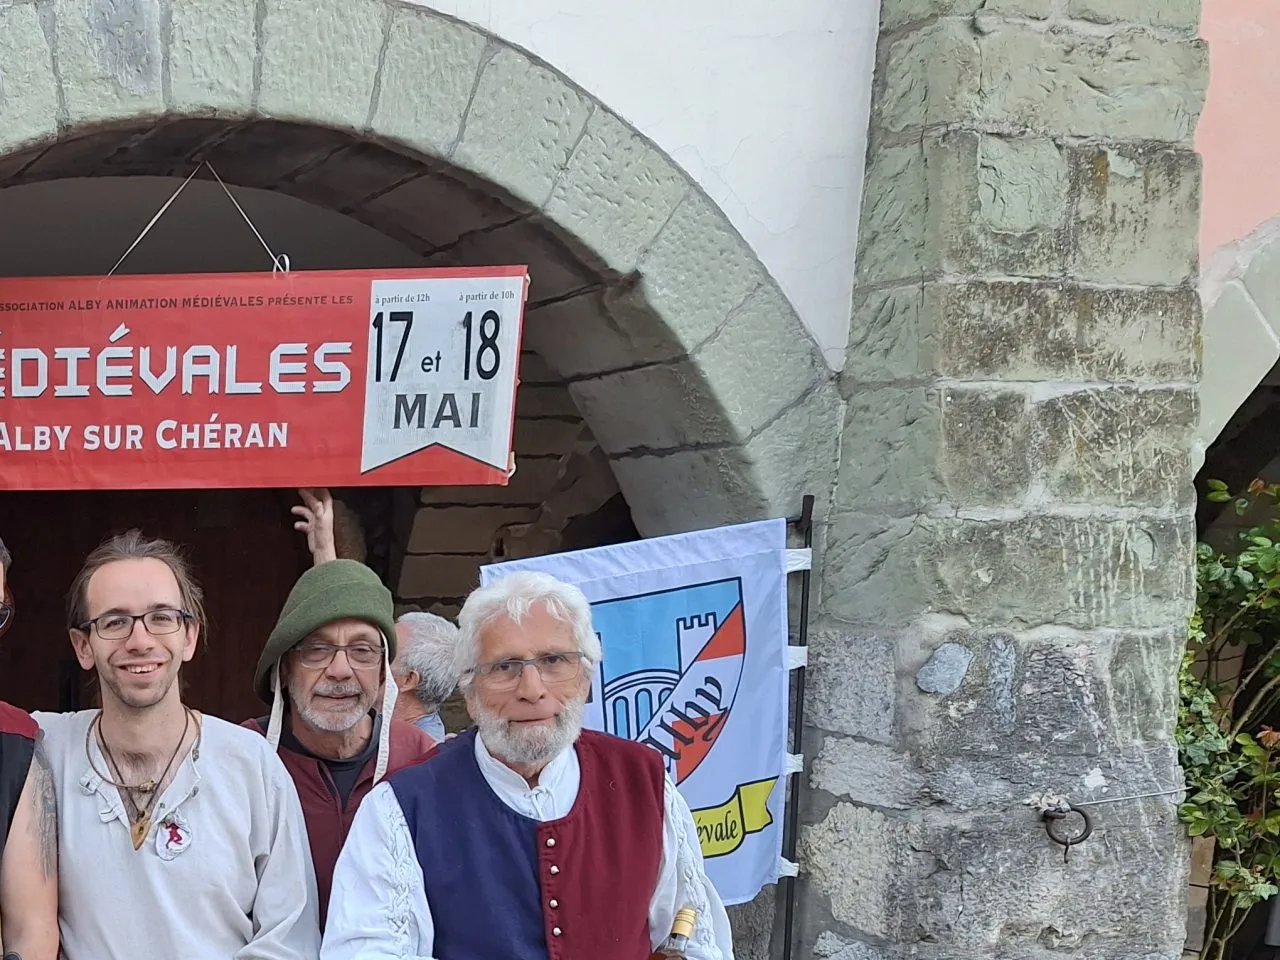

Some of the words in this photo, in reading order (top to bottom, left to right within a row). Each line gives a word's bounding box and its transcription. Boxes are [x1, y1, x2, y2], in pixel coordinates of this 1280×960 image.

[68, 300, 101, 311] ALBY
[106, 297, 178, 310] ANIMATION
[182, 294, 264, 308] MÉDIÉVALES
[267, 293, 328, 306] PRÉSENTE
[332, 295, 354, 305] LES
[381, 294, 404, 306] partir
[404, 293, 415, 303] de
[416, 293, 430, 302] 12h
[465, 291, 488, 304] partir
[489, 290, 499, 300] de
[372, 311, 414, 382] 17
[421, 350, 442, 373] et
[462, 309, 501, 380] 18
[392, 392, 482, 430] MAI
[83, 423, 144, 451] SUR
[156, 413, 289, 449] CHÉRAN
